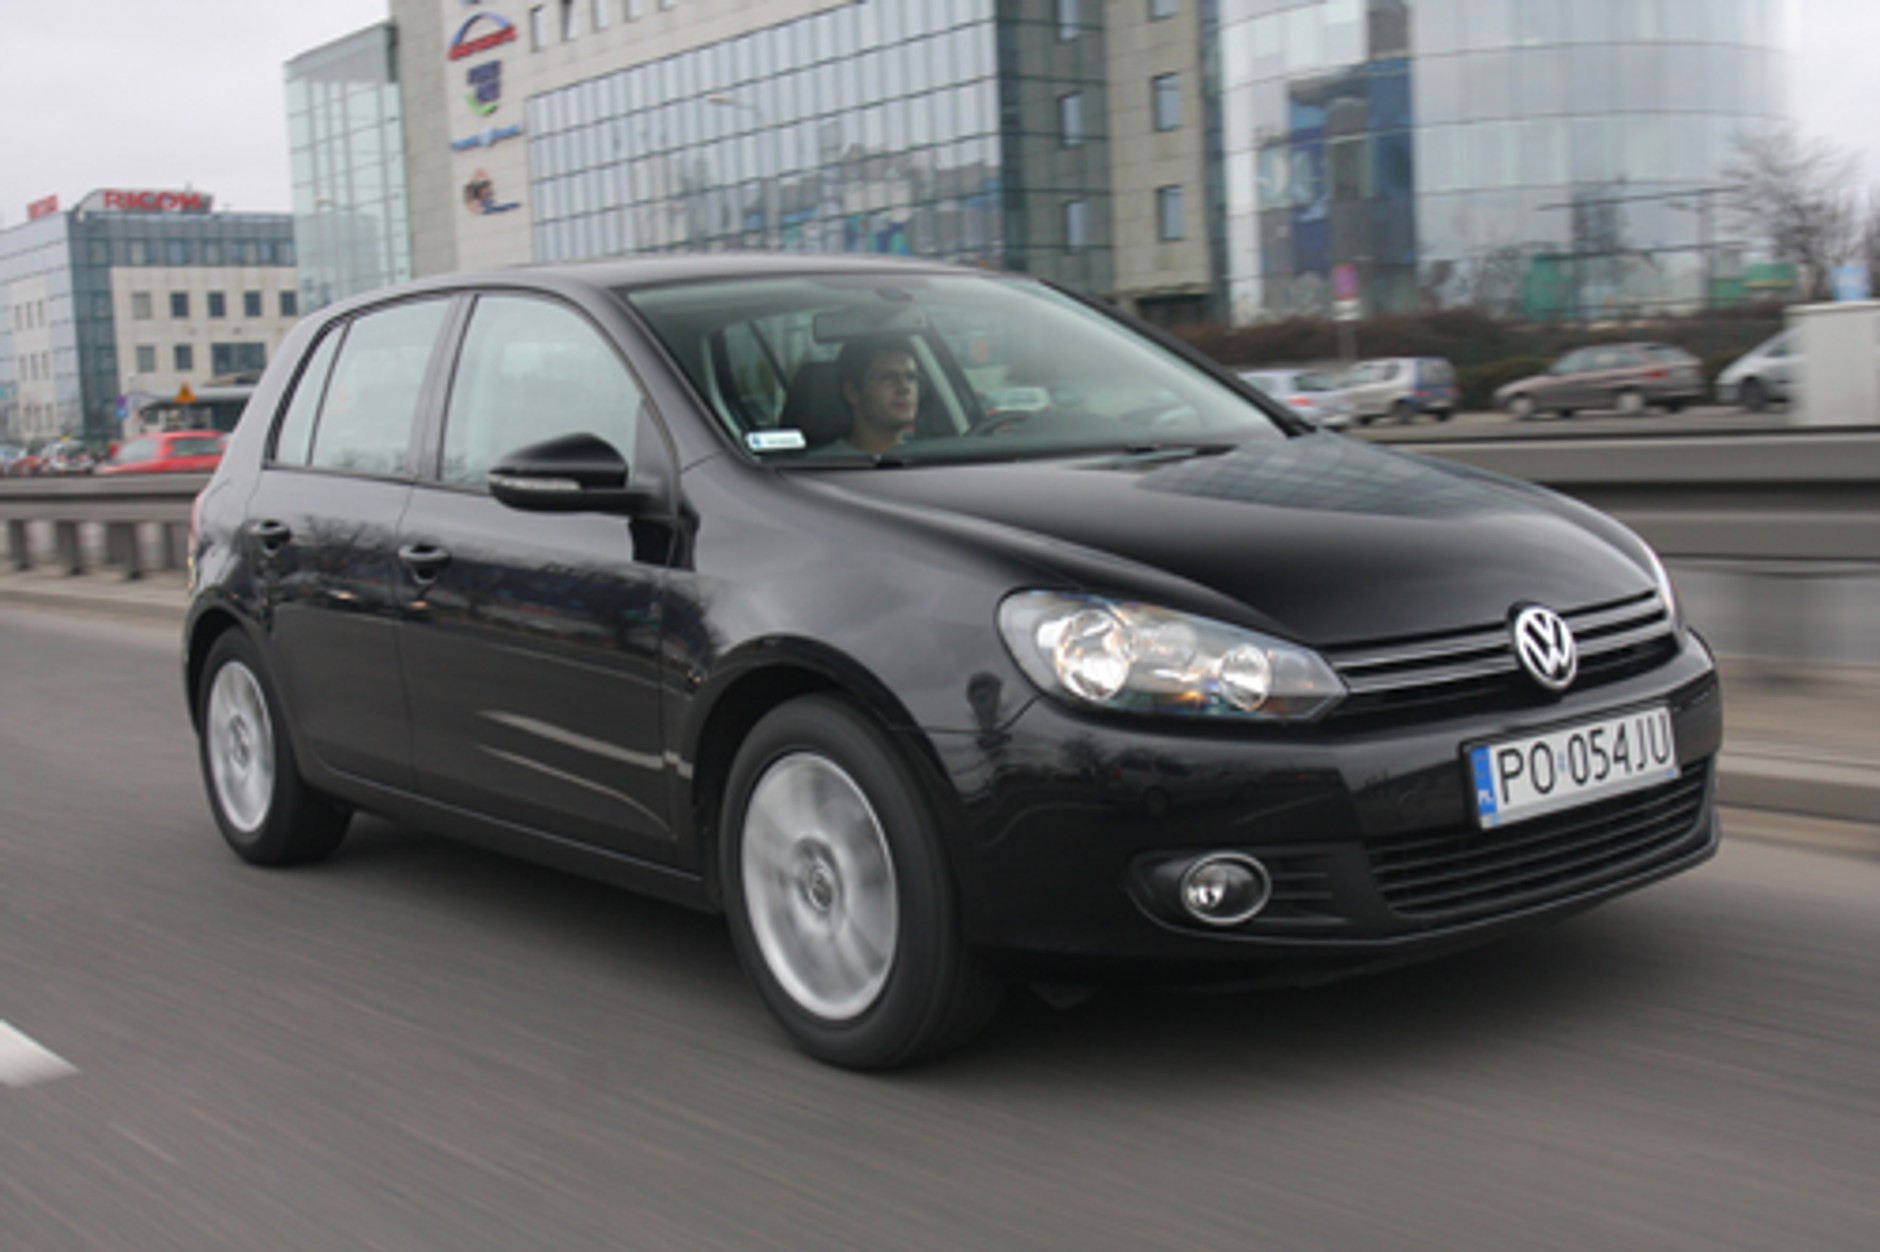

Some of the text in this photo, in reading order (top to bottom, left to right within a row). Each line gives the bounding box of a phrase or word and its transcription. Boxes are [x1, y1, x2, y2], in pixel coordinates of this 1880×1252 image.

[104, 190, 201, 212] RICOH
[1498, 712, 1671, 807] PO 054JU
